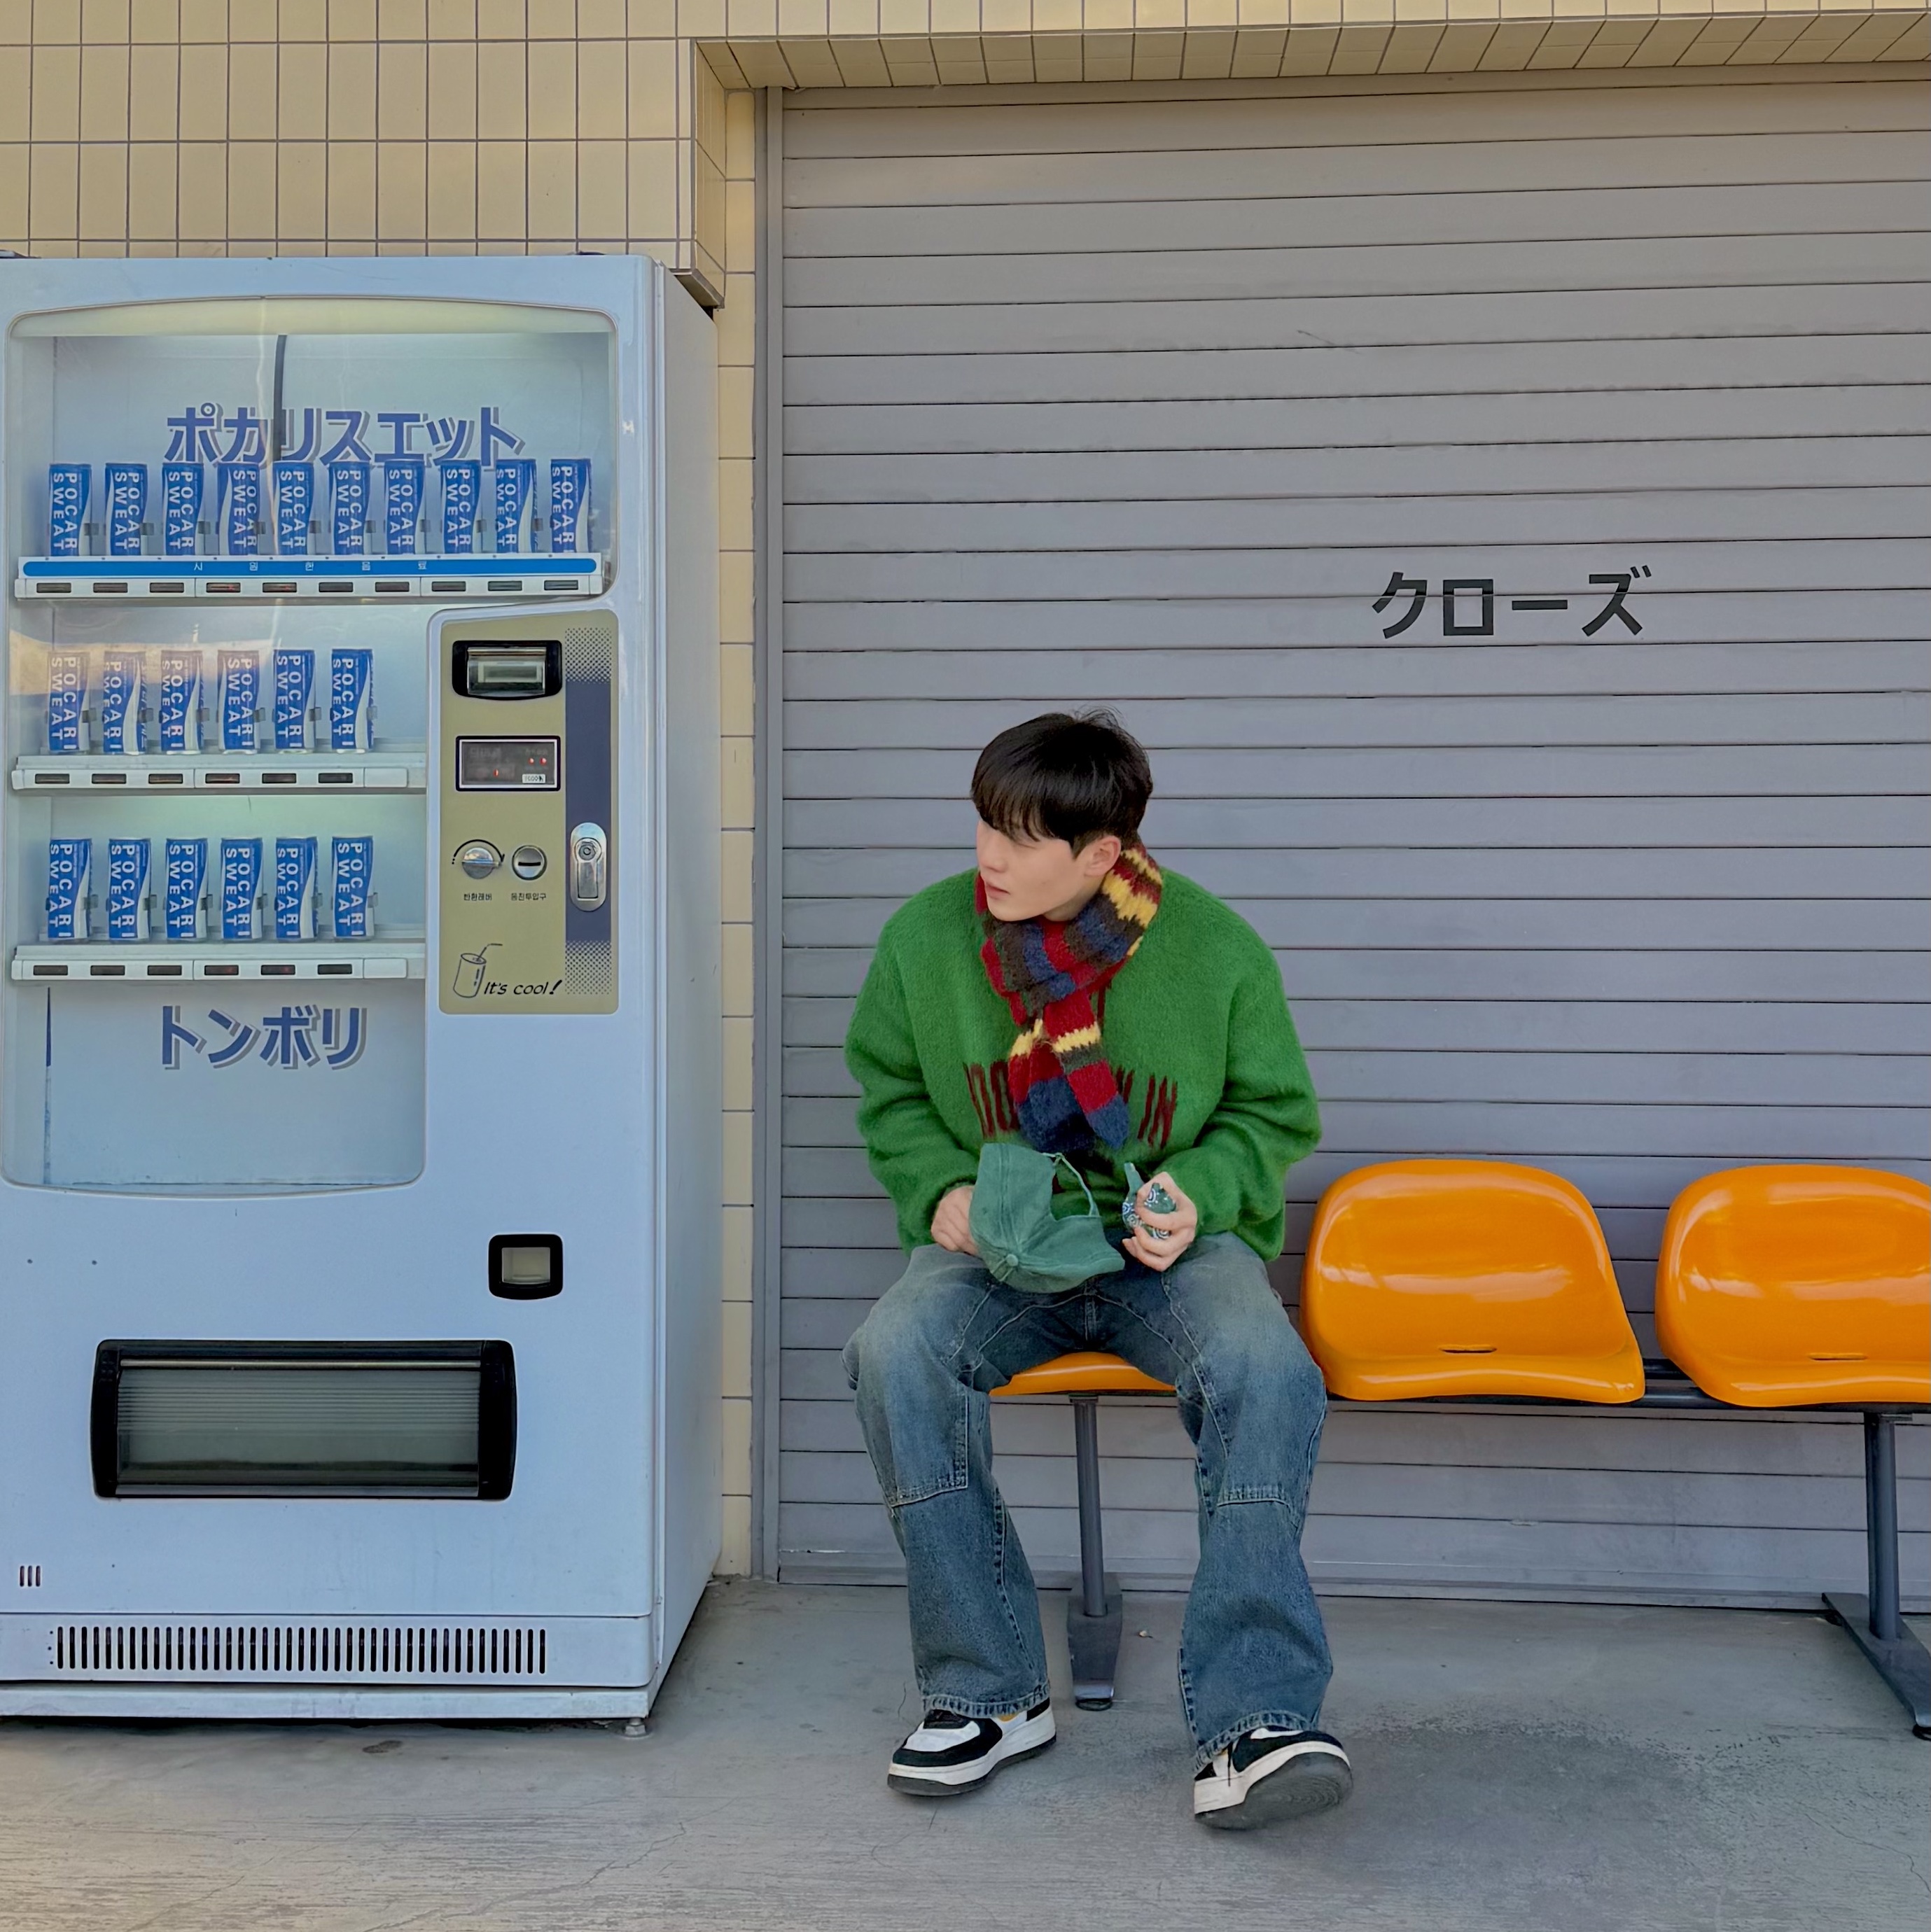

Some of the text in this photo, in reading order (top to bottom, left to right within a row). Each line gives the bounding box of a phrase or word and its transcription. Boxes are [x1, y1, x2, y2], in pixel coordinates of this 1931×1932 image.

[164, 402, 522, 467] ポカリスエット
[53, 472, 64, 550] SWEAT
[64, 472, 77, 549] POCAR
[114, 472, 127, 550] SWEAT
[127, 472, 139, 548] POCAR
[168, 471, 181, 549] SWEAT
[181, 471, 194, 547] POCAR
[232, 470, 246, 547] SWEAT
[246, 470, 257, 546] POCAR
[281, 471, 293, 549] SWEAT
[293, 471, 305, 547] POCAR
[337, 470, 349, 547] SWEAT
[349, 470, 362, 546] POCAR
[389, 469, 400, 547] SWEAT
[400, 469, 414, 545] POCAR
[446, 469, 459, 547] SWEAT
[458, 469, 471, 545] POCAR
[496, 469, 506, 547] SWEAT
[504, 468, 517, 545] POCAR
[552, 467, 562, 545] SWEAT
[1372, 565, 1652, 639] クローズ
[51, 657, 62, 740] SWEAT
[63, 657, 76, 750] POCARI
[110, 661, 122, 748] POCARI
[162, 660, 170, 738] SWEAT
[170, 660, 183, 748] POCARI
[228, 658, 240, 736] SWEAT
[240, 659, 253, 746] POCARI
[277, 656, 288, 738] SWEAT
[288, 655, 302, 748] POCARI
[333, 659, 341, 736] SWEAT
[342, 659, 354, 746] POCARI
[49, 844, 59, 928] SWEAT
[58, 844, 73, 937] POCARI
[111, 845, 122, 928] SWEAT
[121, 845, 135, 938] POCARI
[169, 845, 181, 928] SWEAT
[181, 845, 194, 938] POCARI
[225, 848, 237, 926] SWEAT
[237, 848, 250, 936] POCARI
[277, 848, 286, 926] SWEAT
[286, 848, 299, 936] POCARI
[337, 843, 350, 926] SWEAT
[350, 843, 364, 936] POCARI
[484, 981, 508, 995] It's
[162, 1004, 368, 1070] トンボリ
